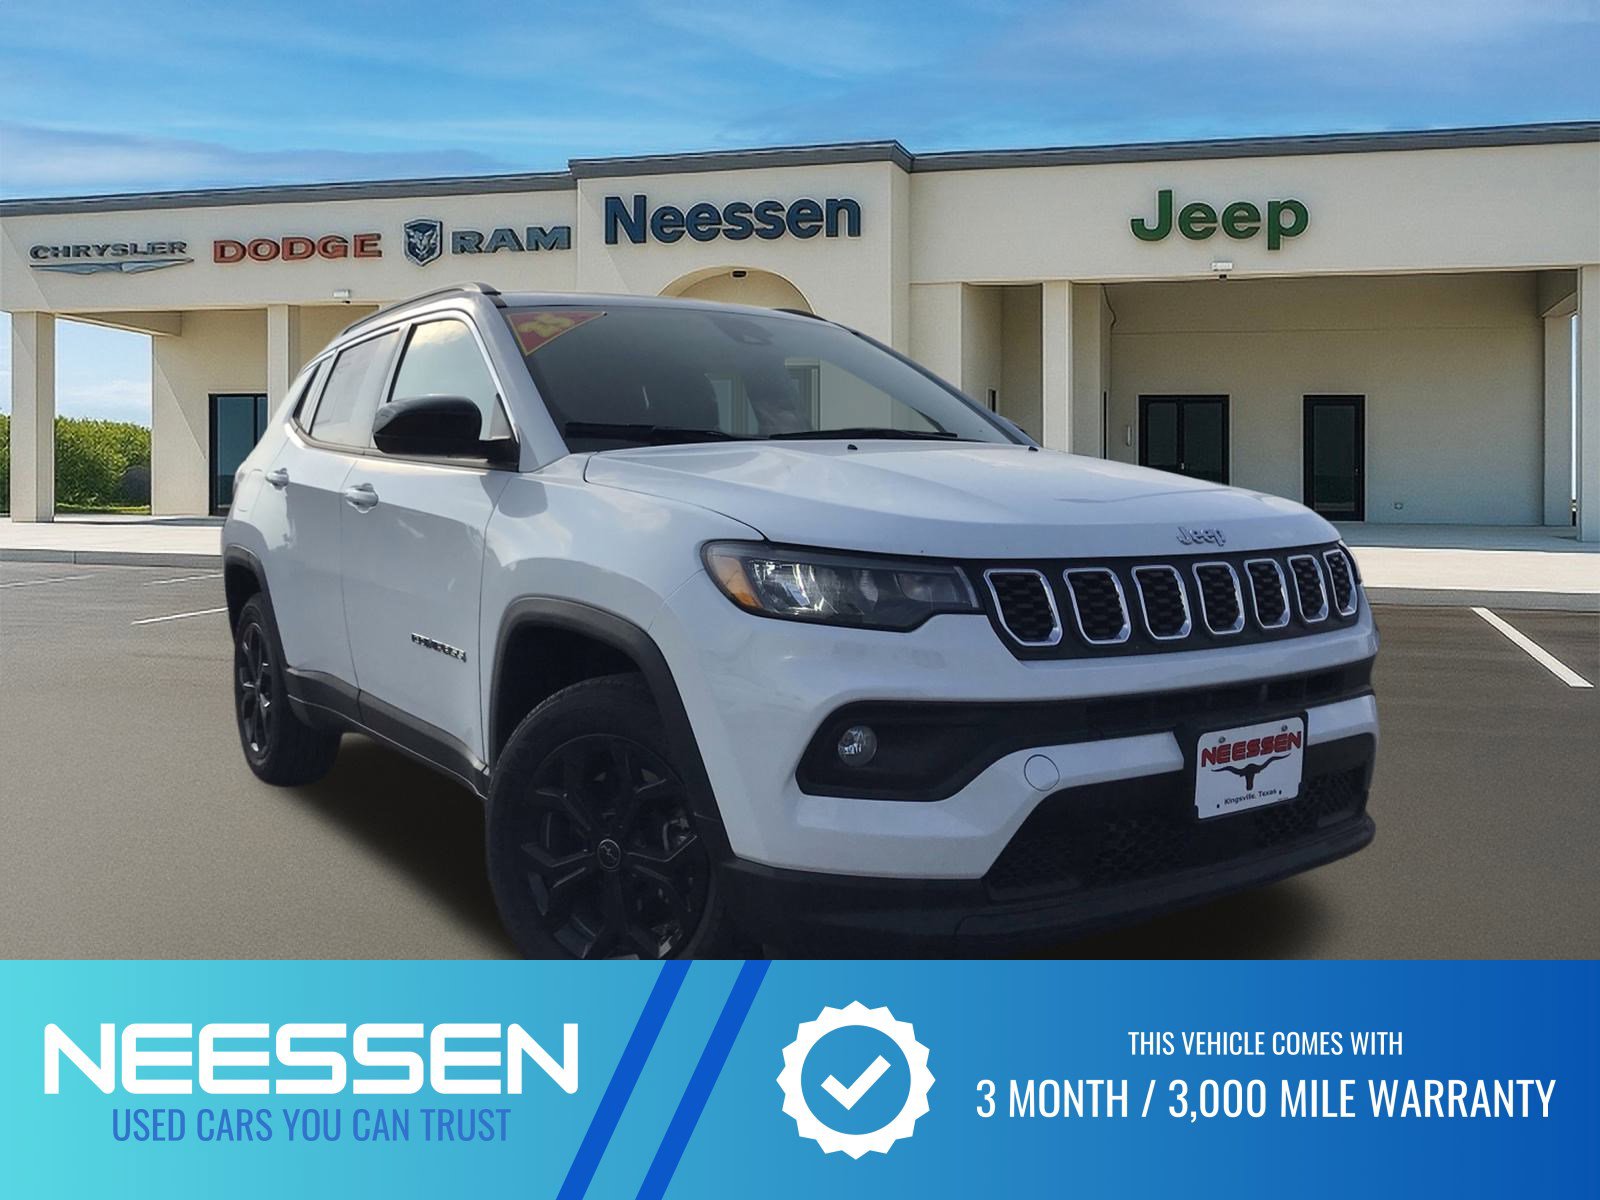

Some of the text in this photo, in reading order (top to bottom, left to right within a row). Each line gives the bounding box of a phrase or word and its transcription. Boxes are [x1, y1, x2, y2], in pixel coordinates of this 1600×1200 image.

[604, 194, 862, 245] Neessen
[1130, 189, 1309, 251] Jeep
[29, 240, 188, 260] CHRYSLER
[213, 233, 383, 264] DODGE
[451, 225, 572, 255] RAM
[1176, 525, 1226, 547] Jeep
[1200, 731, 1302, 768] NEESSEN
